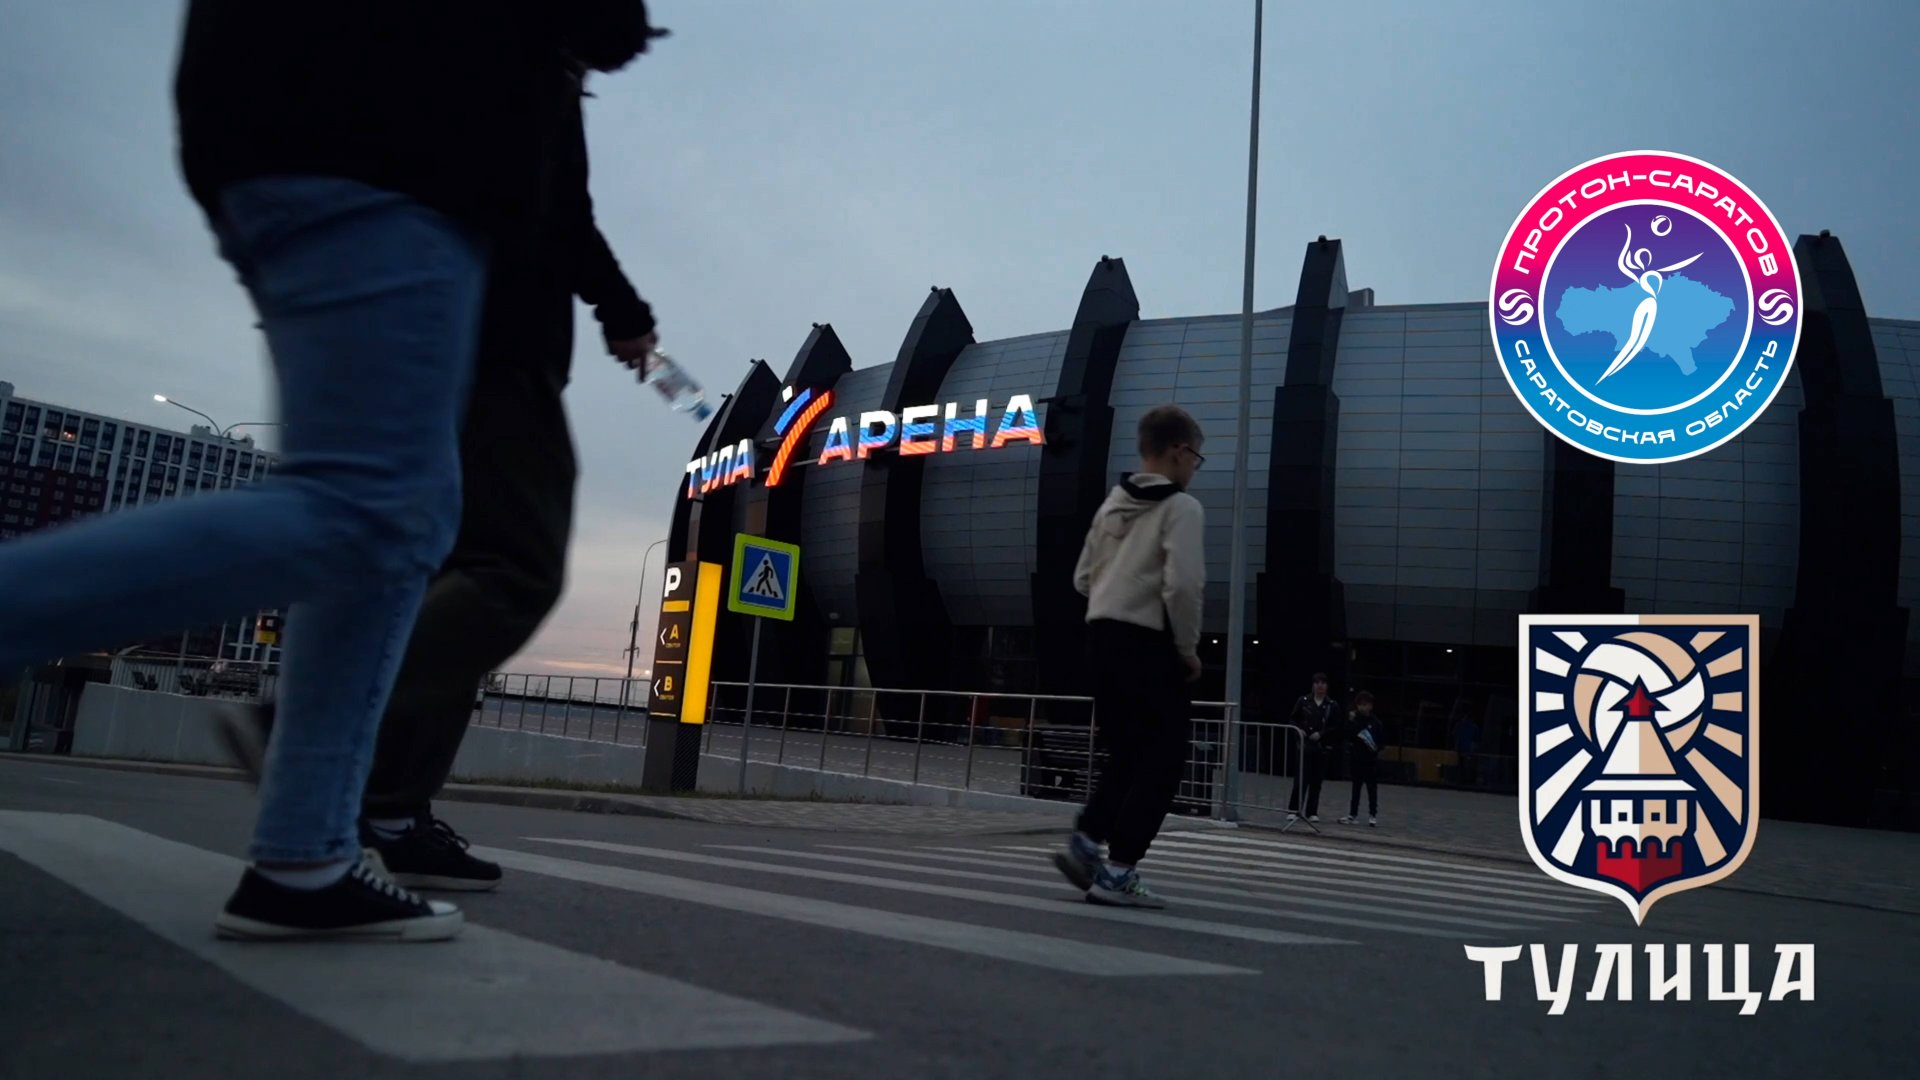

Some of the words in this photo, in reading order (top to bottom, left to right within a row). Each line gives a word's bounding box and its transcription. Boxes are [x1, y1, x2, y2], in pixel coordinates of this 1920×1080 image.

[685, 438, 756, 500] ТУЛА
[817, 393, 1046, 466] АРЕНА
[664, 567, 681, 597] P
[670, 625, 679, 640] A
